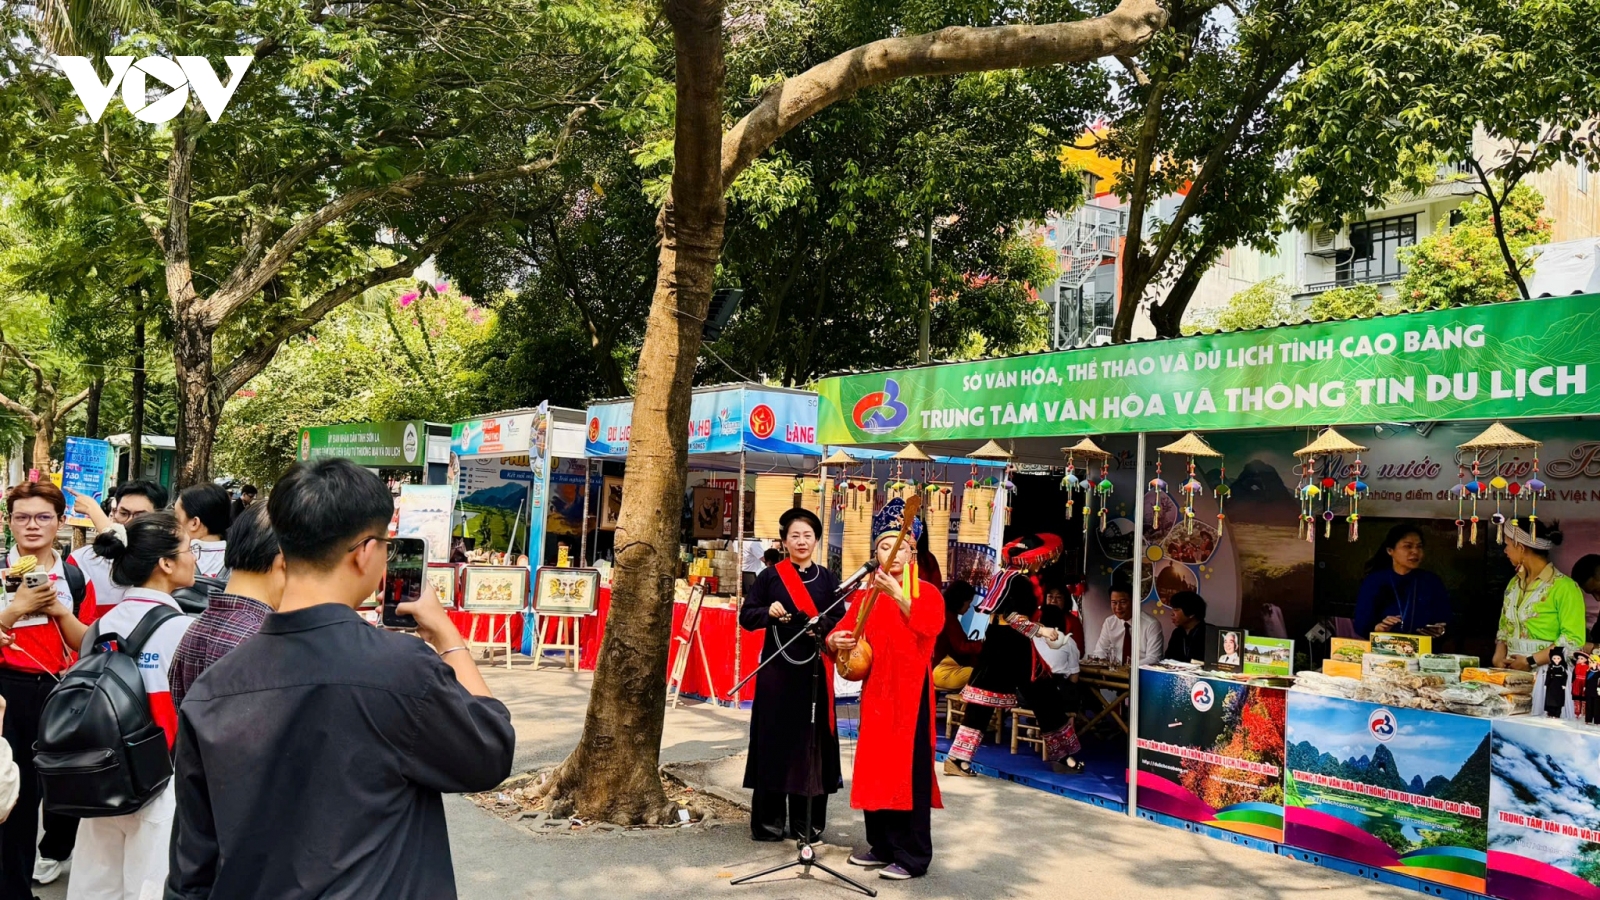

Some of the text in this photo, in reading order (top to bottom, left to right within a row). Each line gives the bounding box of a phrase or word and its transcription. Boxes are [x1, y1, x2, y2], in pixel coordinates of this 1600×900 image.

[963, 324, 1486, 392] SỞ VĂN HÓA, THỂ THAO VÀ DU LỊCH TỈNH CAO BẰNG
[920, 364, 1588, 429] TRUNG TÂM VĂN HÓA VÀ THÔNG TIN DU LỊCH
[619, 424, 632, 443] LỊC
[786, 422, 815, 443] LÀNG
[1376, 455, 1443, 480] nước
[1367, 488, 1403, 502] những
[1404, 487, 1433, 501] điểm
[1559, 489, 1587, 504] Việt
[139, 651, 160, 663] ege
[1188, 749, 1205, 761] THÔNG
[1204, 753, 1214, 763] TIN
[1214, 755, 1222, 765] DU
[1249, 763, 1262, 772] CAO
[1293, 769, 1482, 819] TRUNG TÂM VĂN HÓA VÀ THÔNG TIN DU LỊCH TỈNH CAO BẰNG
[1498, 811, 1525, 826] TRUNG
[1525, 815, 1543, 830] TÂM
[1544, 820, 1560, 833] VĂN
[1561, 824, 1579, 838] HÓA
[1580, 826, 1592, 840] VÀ
